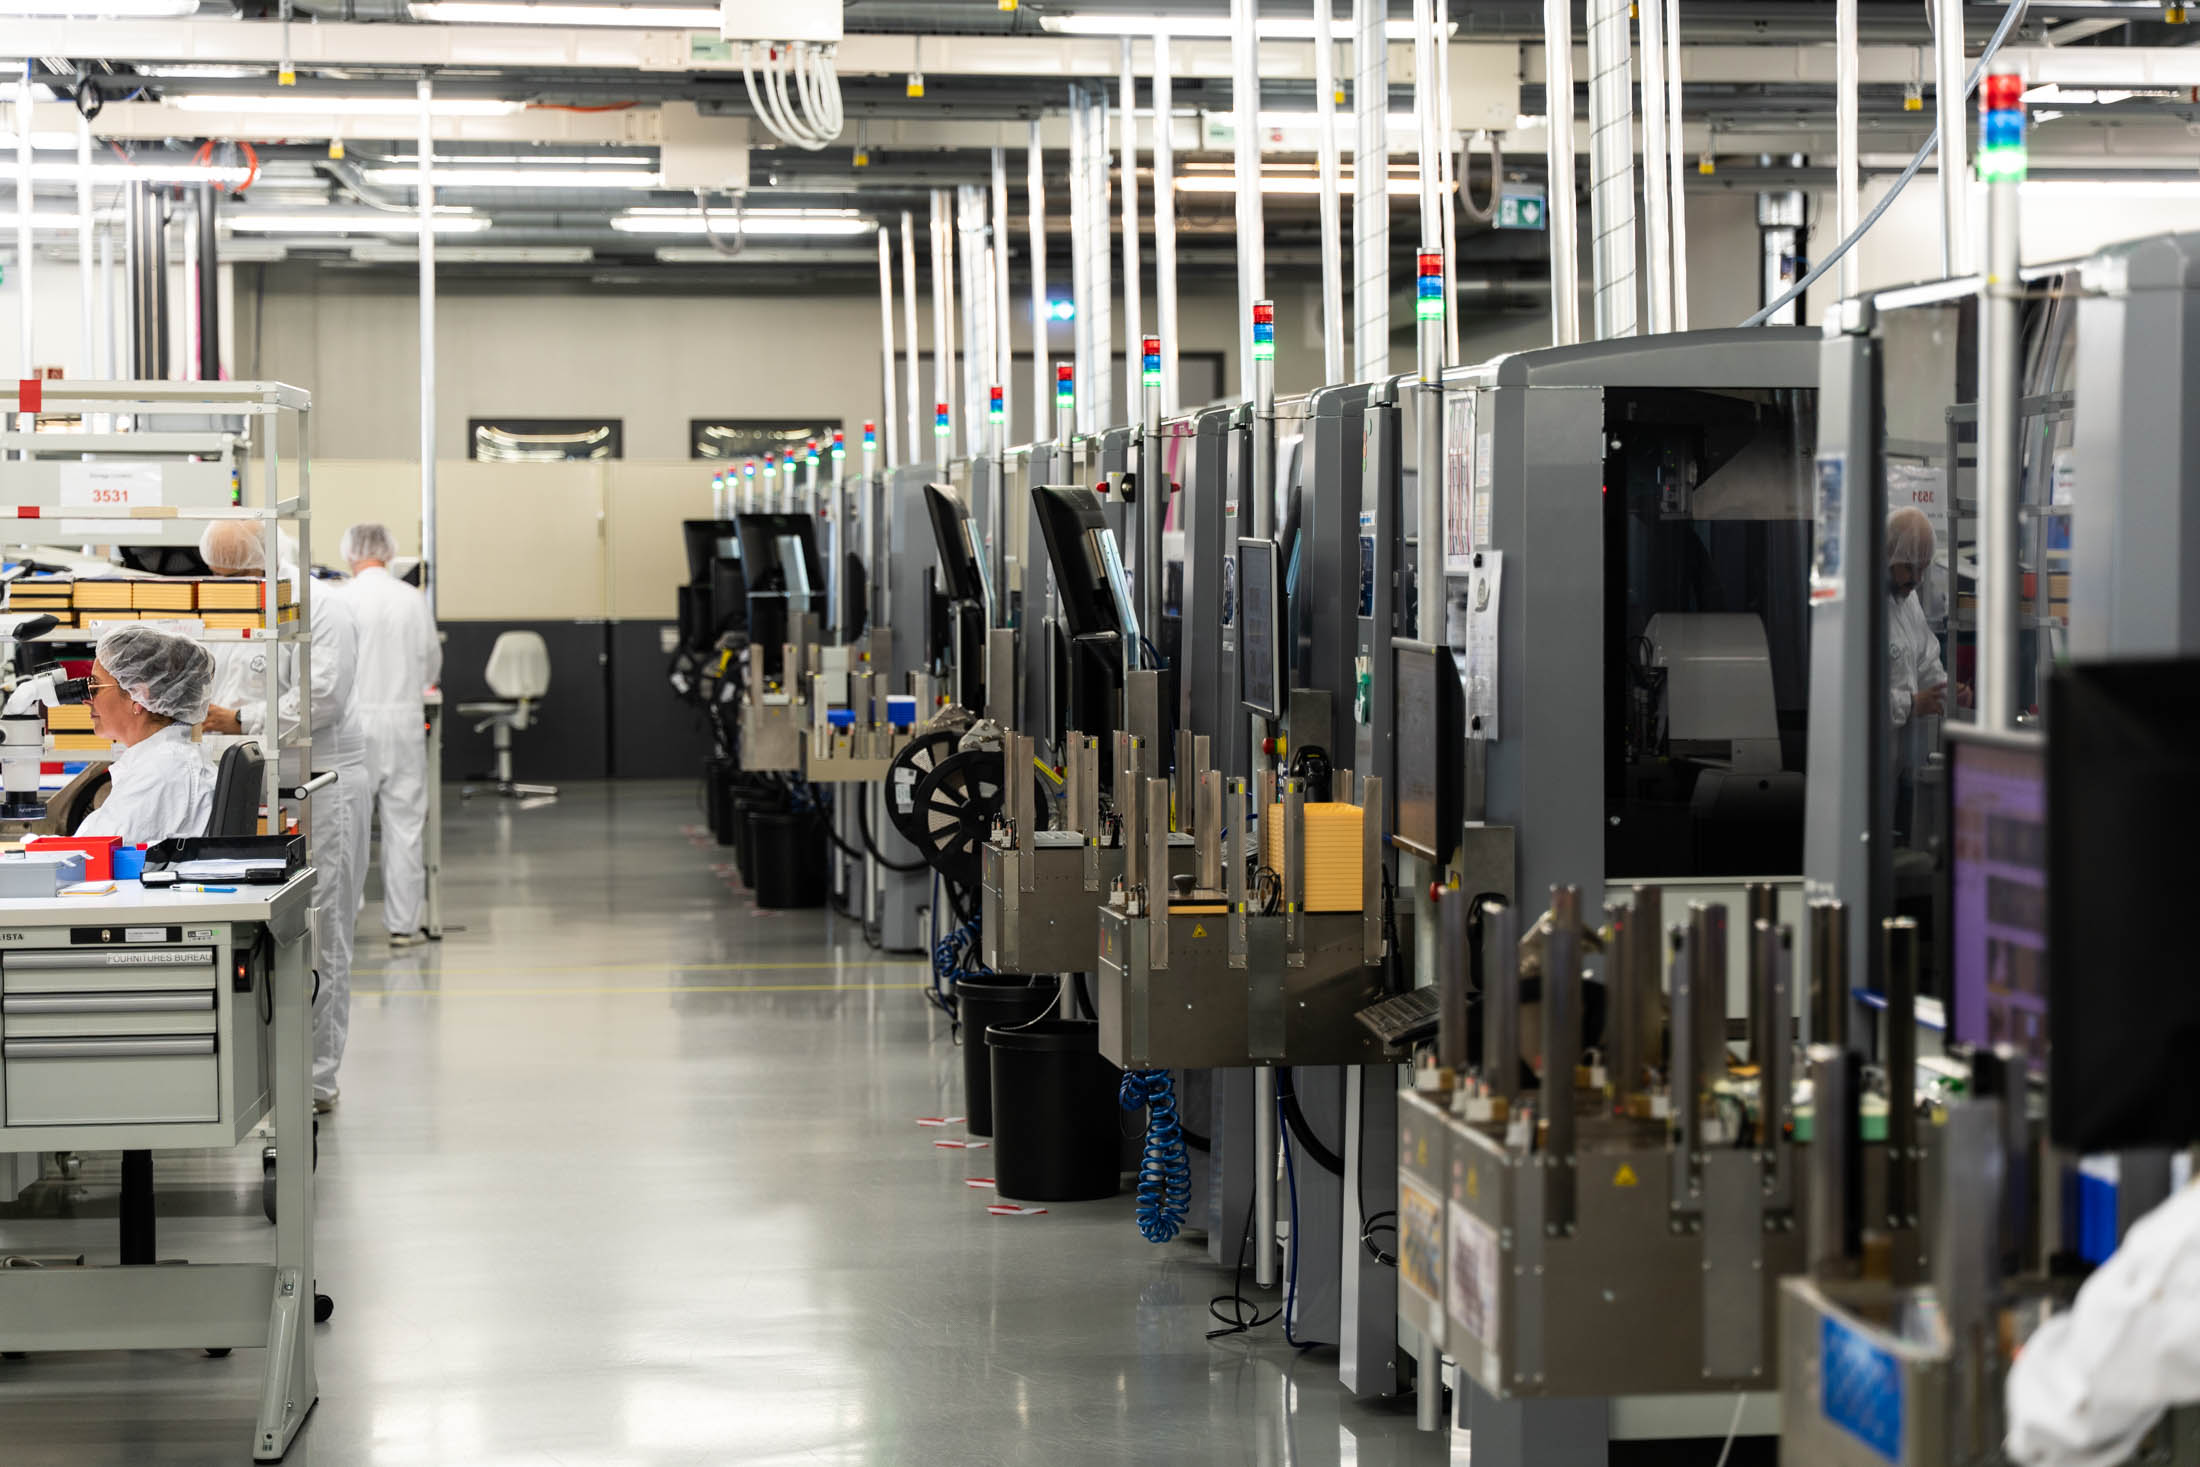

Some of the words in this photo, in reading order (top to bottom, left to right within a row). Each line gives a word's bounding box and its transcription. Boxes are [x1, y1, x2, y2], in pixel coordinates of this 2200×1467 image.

[92, 488, 129, 503] 3531
[0, 933, 23, 941] ISTA
[107, 954, 172, 963] FOURNITURES
[174, 953, 212, 962] BUREAU
